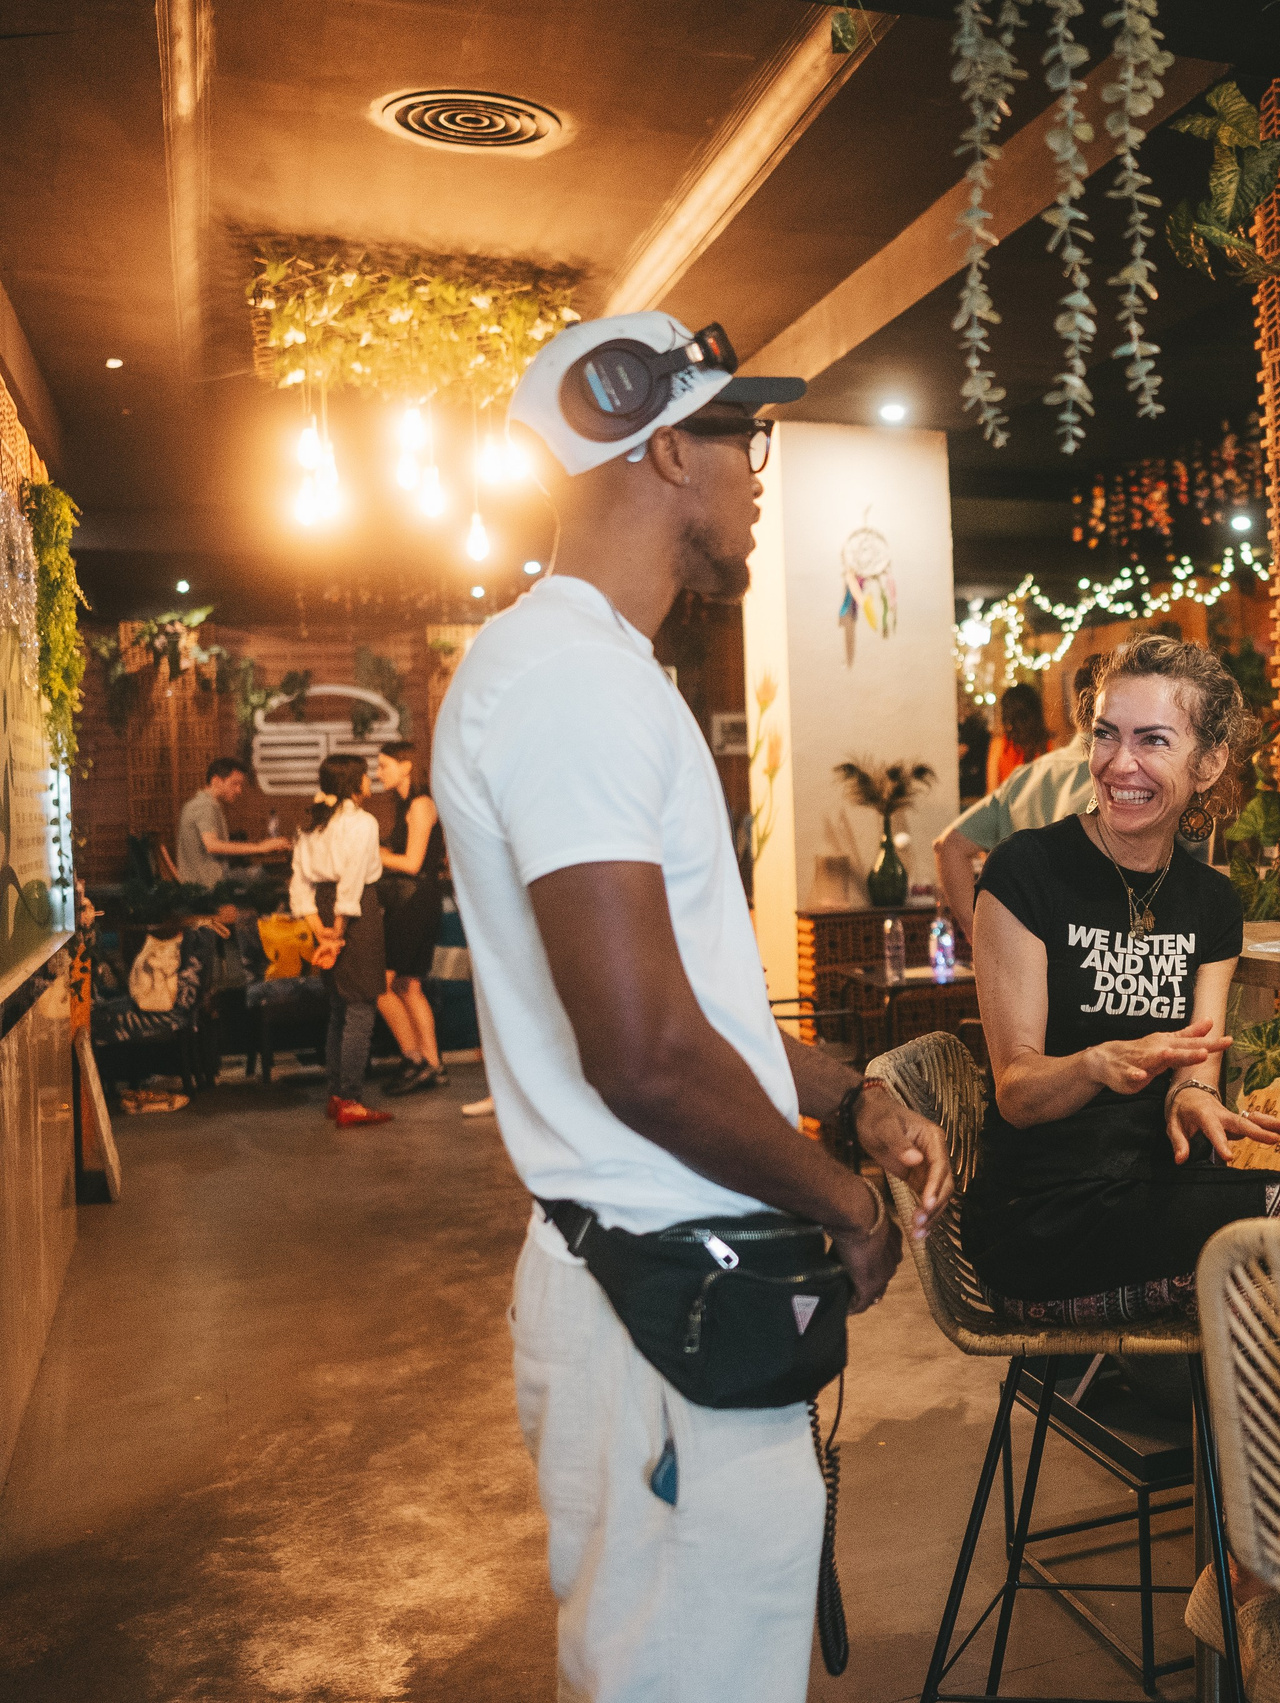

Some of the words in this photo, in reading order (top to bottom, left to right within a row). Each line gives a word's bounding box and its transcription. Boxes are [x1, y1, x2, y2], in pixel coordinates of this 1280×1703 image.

[1068, 923, 1110, 950] WE
[1115, 932, 1195, 955] LISTEN
[1080, 949, 1143, 974] AND
[1149, 954, 1188, 975] WE
[1094, 971, 1183, 997] DON'T
[1080, 992, 1186, 1020] JUDGE
